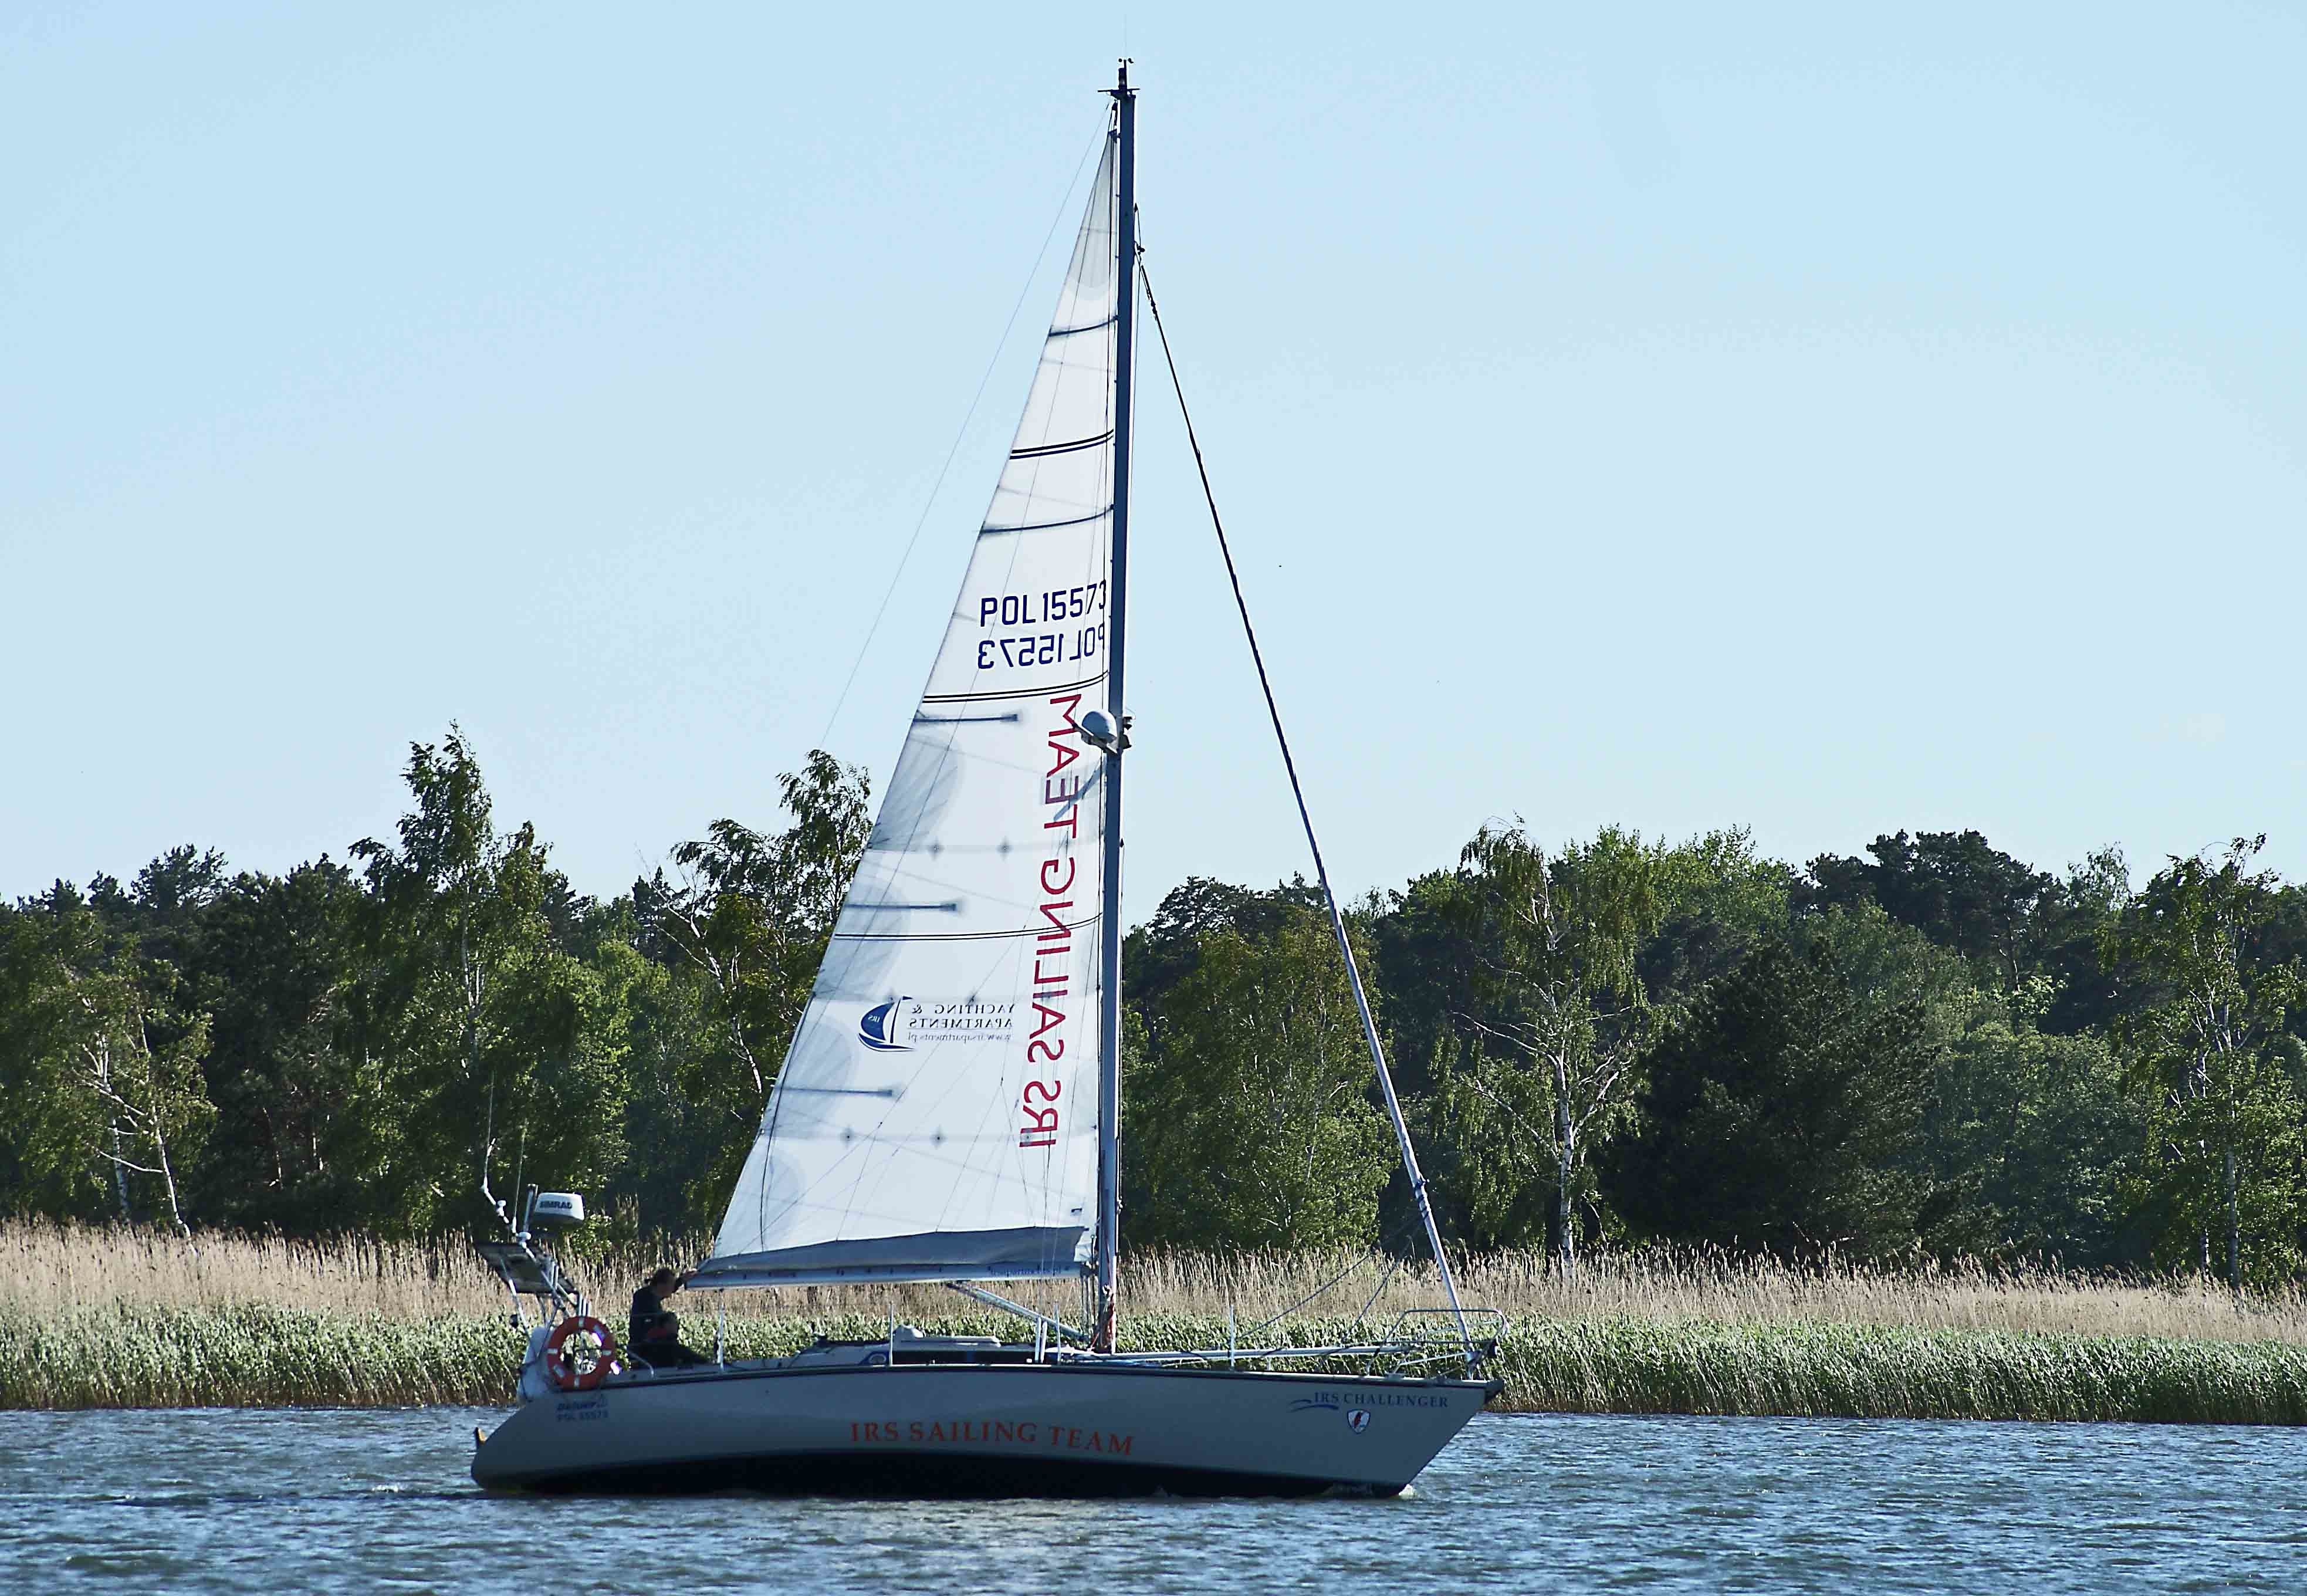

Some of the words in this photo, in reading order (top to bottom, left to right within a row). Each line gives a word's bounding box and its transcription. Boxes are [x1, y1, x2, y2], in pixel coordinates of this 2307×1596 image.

[980, 594, 1036, 627] POL
[1042, 579, 1107, 622] 15573
[1314, 1392, 1339, 1403] IRS
[1343, 1393, 1449, 1408] CHALLENGER
[851, 1421, 901, 1442] IRS
[909, 1421, 1038, 1443] SAILING
[1047, 1425, 1135, 1456] TEAM
